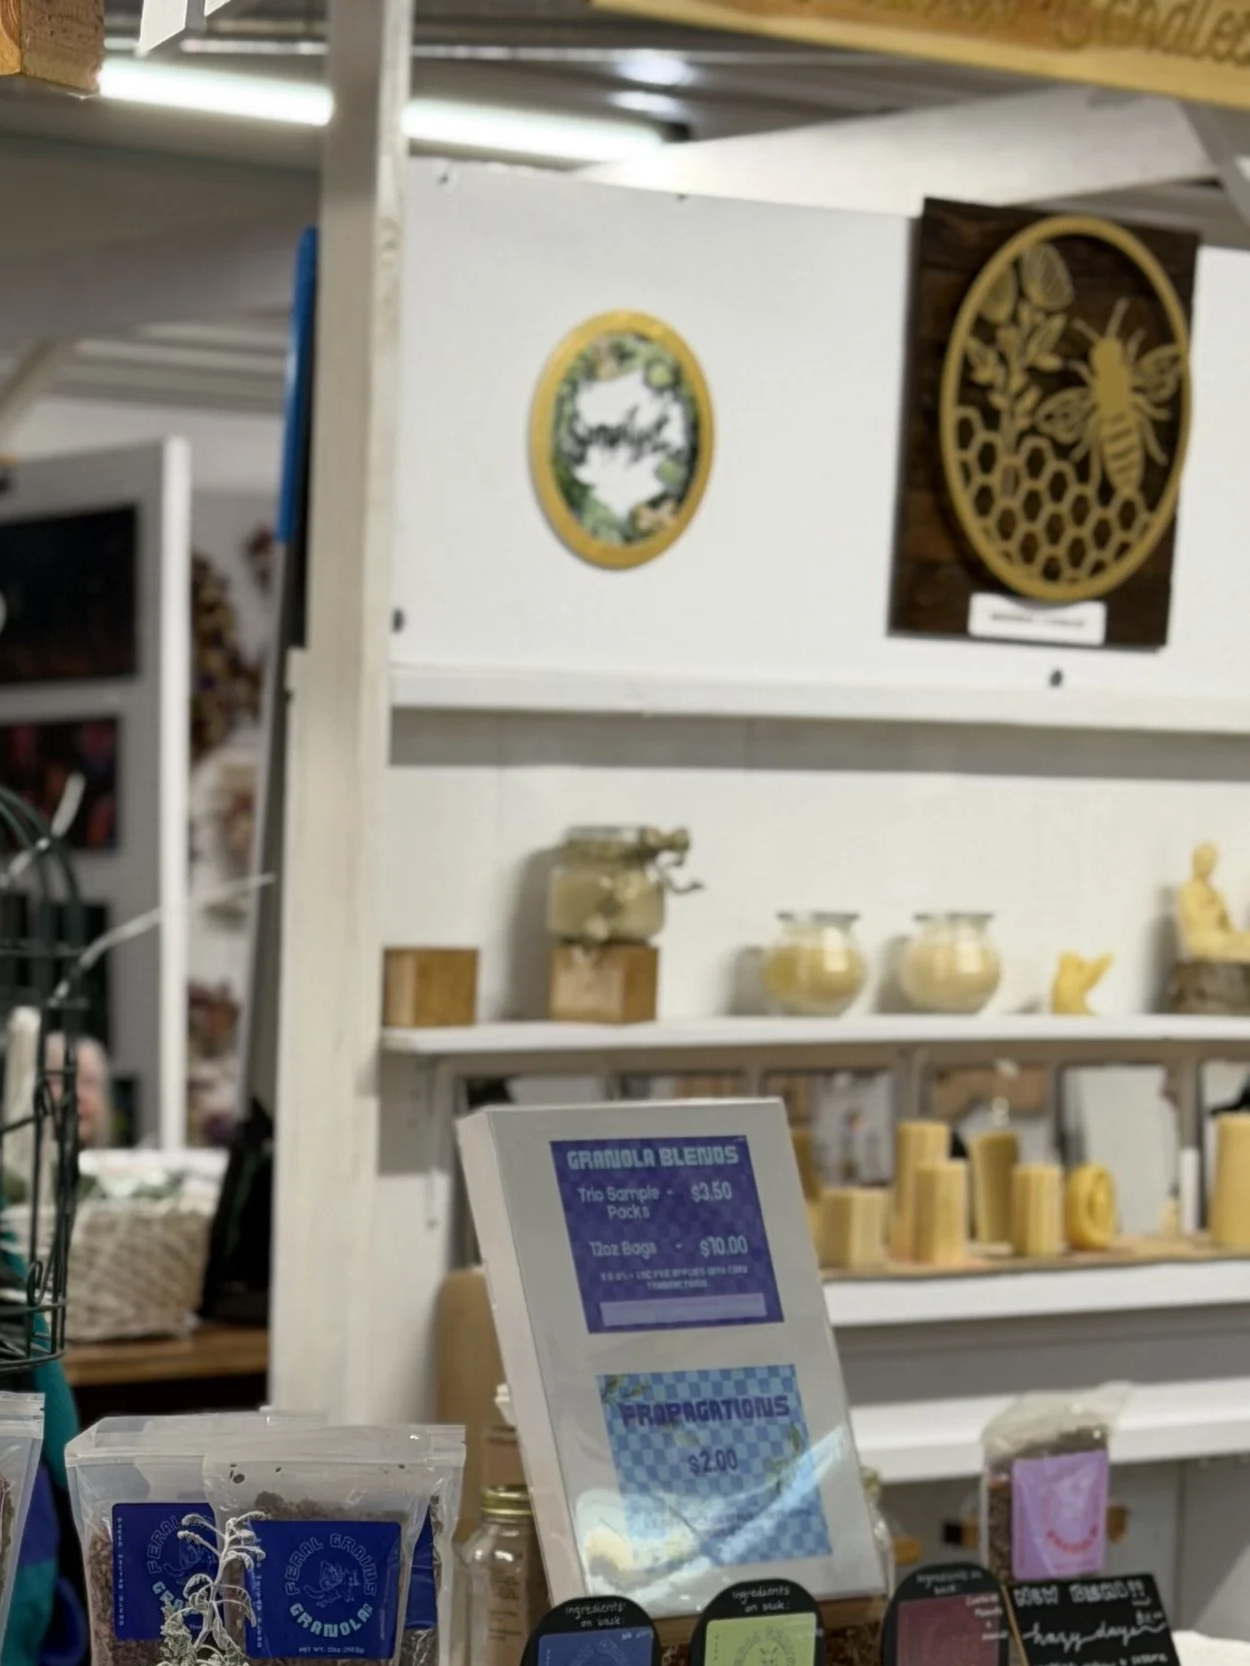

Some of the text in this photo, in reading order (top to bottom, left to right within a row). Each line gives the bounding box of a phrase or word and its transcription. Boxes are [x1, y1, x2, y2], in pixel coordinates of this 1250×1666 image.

[567, 1146, 739, 1170] GRANOLA BLENDS
[577, 1185, 604, 1203] Trio
[607, 1184, 659, 1204] Sample
[691, 1181, 732, 1203] $3.50
[607, 1204, 650, 1220] Packs
[589, 1241, 619, 1257] 12oz
[622, 1241, 657, 1259] Bags
[699, 1235, 749, 1258] $10.00
[618, 1395, 791, 1427] PROPAGATIONS
[688, 1448, 739, 1477] $2.00
[285, 1532, 378, 1597] FERAL GRAINS
[290, 1602, 372, 1637] GRANOLA
